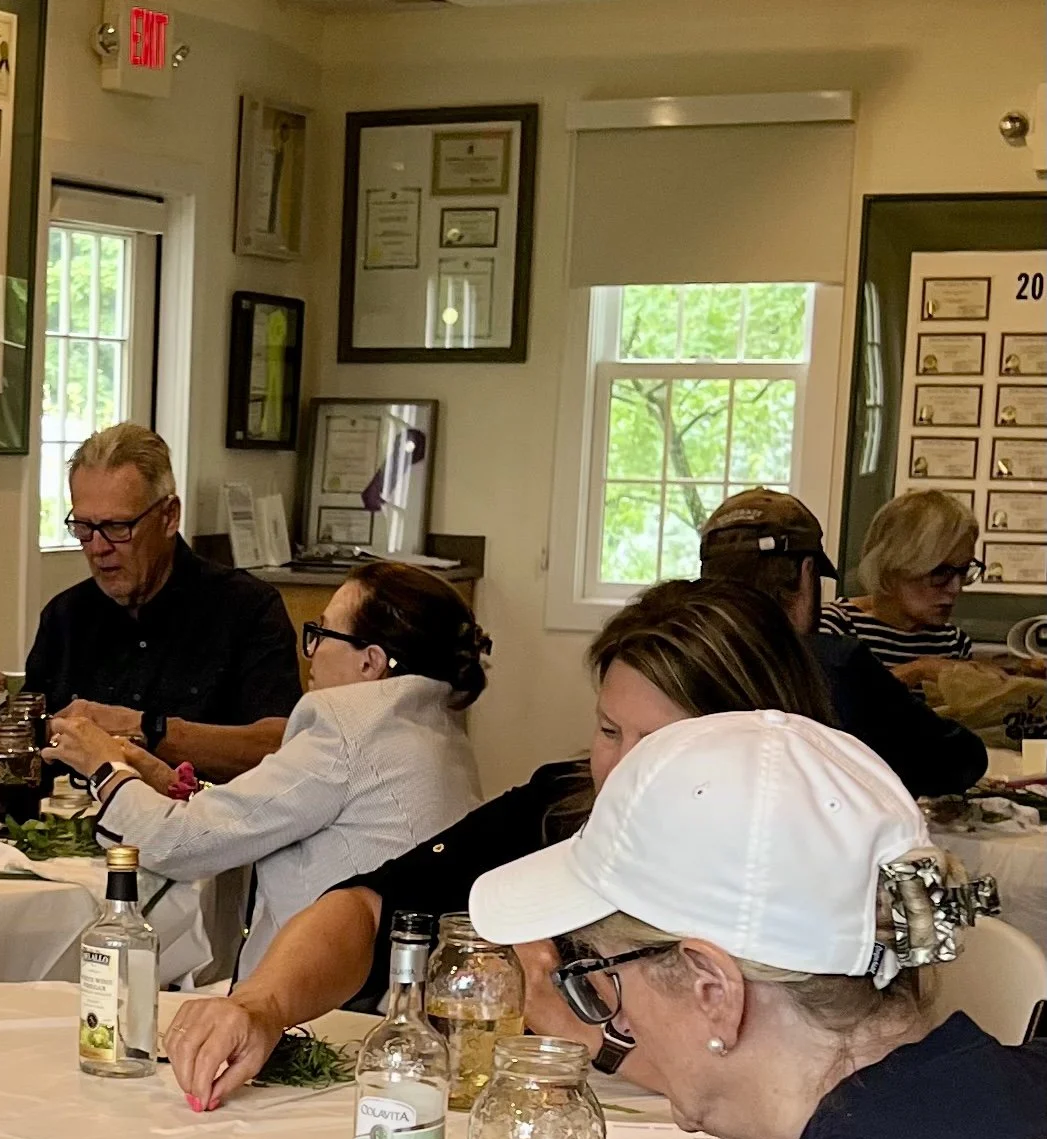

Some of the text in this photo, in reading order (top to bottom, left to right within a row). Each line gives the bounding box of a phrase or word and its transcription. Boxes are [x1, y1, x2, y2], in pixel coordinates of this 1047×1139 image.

[130, 6, 169, 69] EXIT
[1016, 272, 1044, 300] 20
[360, 1103, 409, 1122] COLAVITA
